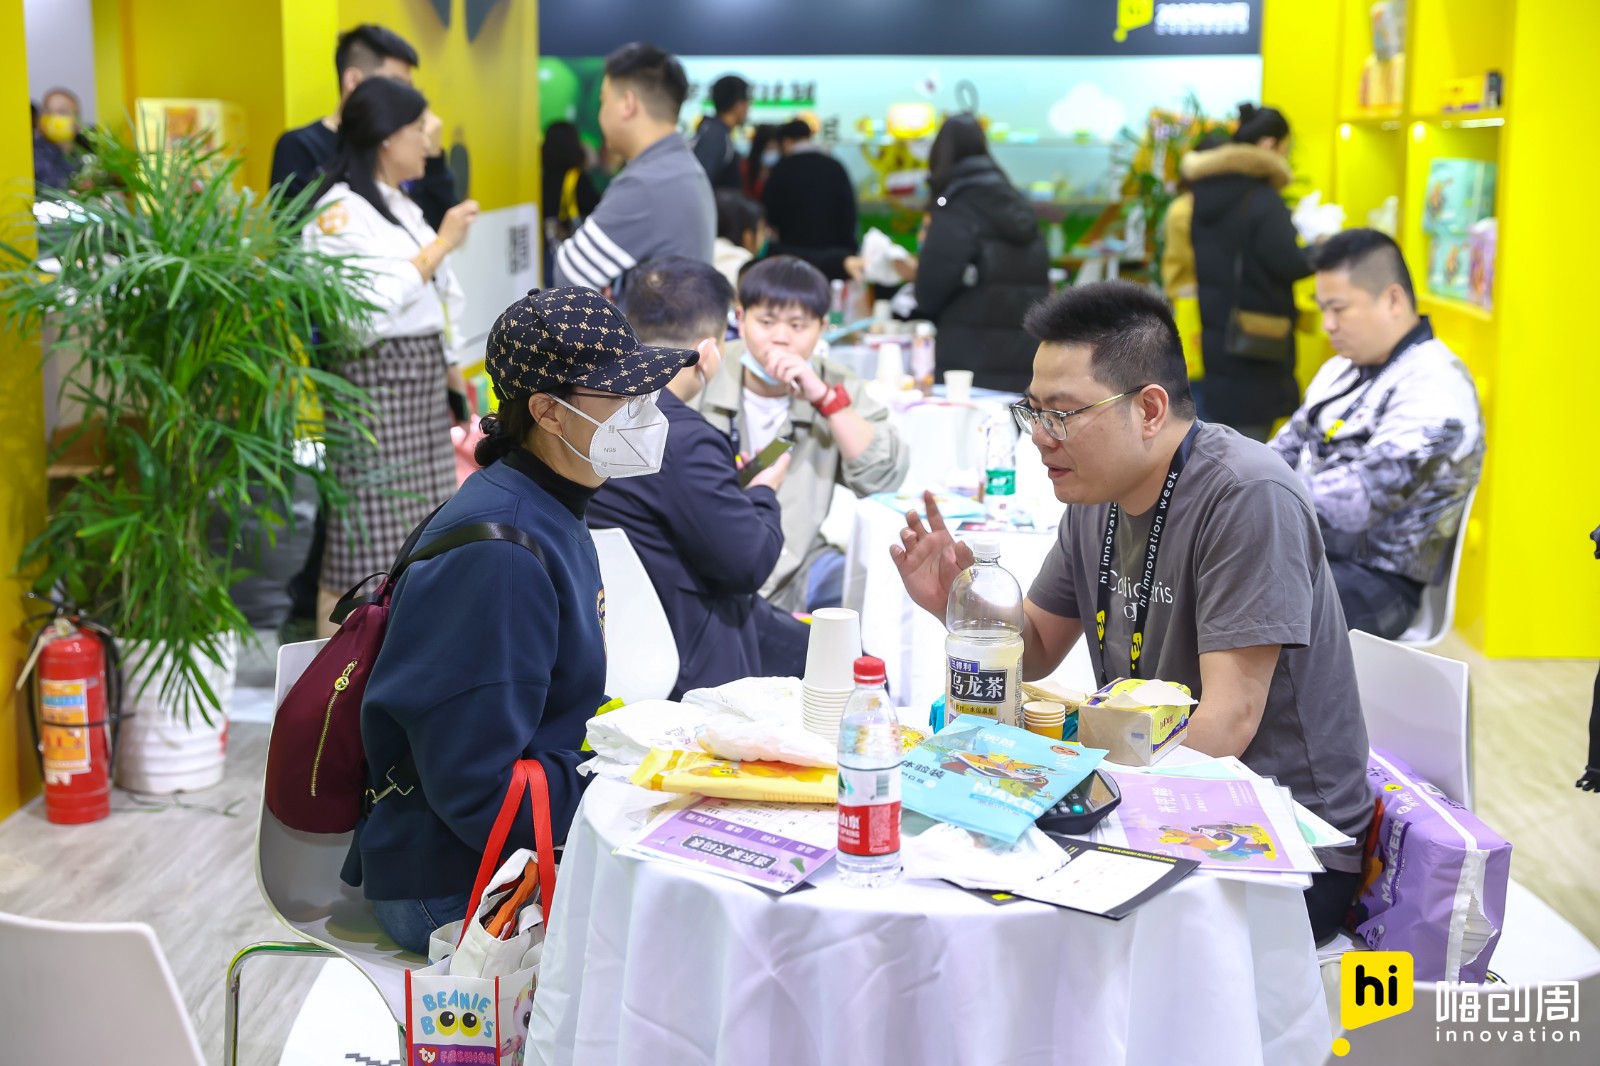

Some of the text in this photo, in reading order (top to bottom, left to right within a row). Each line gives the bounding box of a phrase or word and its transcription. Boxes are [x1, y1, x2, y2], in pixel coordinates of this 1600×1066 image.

[1141, 515, 1163, 590] innovation
[1159, 471, 1178, 509] week
[1100, 567, 1108, 584] hi
[951, 672, 1004, 699] 乌龙茶
[1381, 819, 1405, 905] MAKER
[422, 989, 492, 1013] BEANIE
[418, 1047, 496, 1065] ty FASHION
